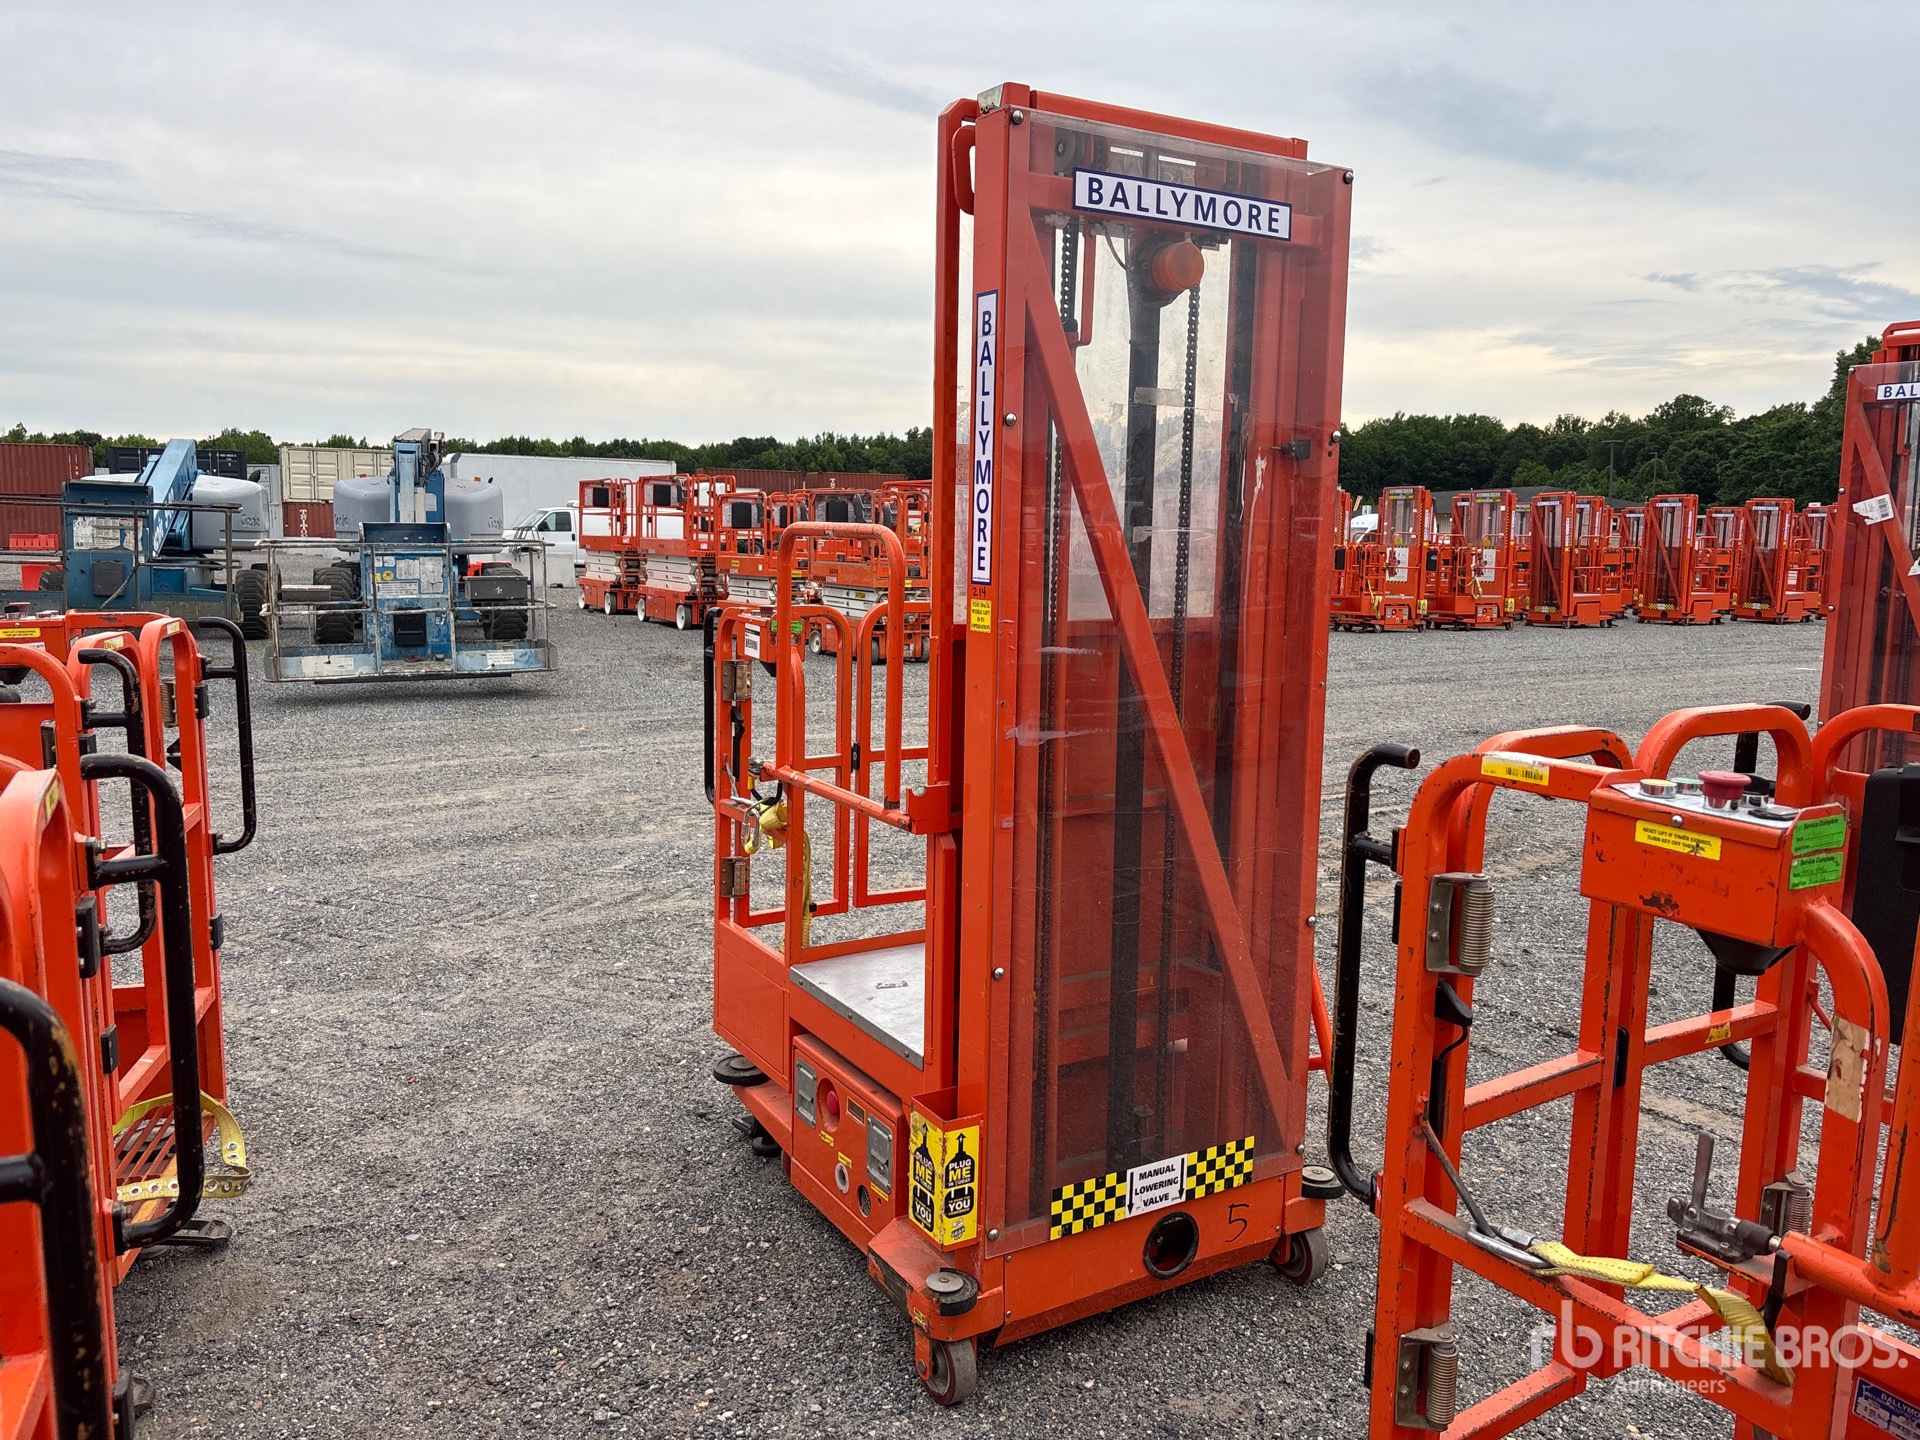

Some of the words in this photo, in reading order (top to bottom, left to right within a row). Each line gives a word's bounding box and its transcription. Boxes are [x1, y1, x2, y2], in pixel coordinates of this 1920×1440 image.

[1088, 177, 1280, 234] BALLYMORE
[975, 310, 993, 571] BALLYMORE
[971, 586, 987, 599] 214
[1642, 827, 1657, 835] RESET
[1657, 829, 1667, 837] LIFT
[1674, 833, 1690, 842] TIMER
[1647, 835, 1660, 843] TURN
[915, 1151, 934, 1172] PLUG
[948, 1158, 972, 1171] PLUG
[915, 1160, 933, 1185] ME
[948, 1166, 972, 1183] ME
[1138, 1164, 1176, 1181] MANUAL
[1134, 1177, 1179, 1196] LOWERING
[948, 1199, 971, 1212] YOU
[1142, 1193, 1170, 1207] VALVE
[915, 1201, 932, 1223] YOU
[1224, 1203, 1250, 1243] 5
